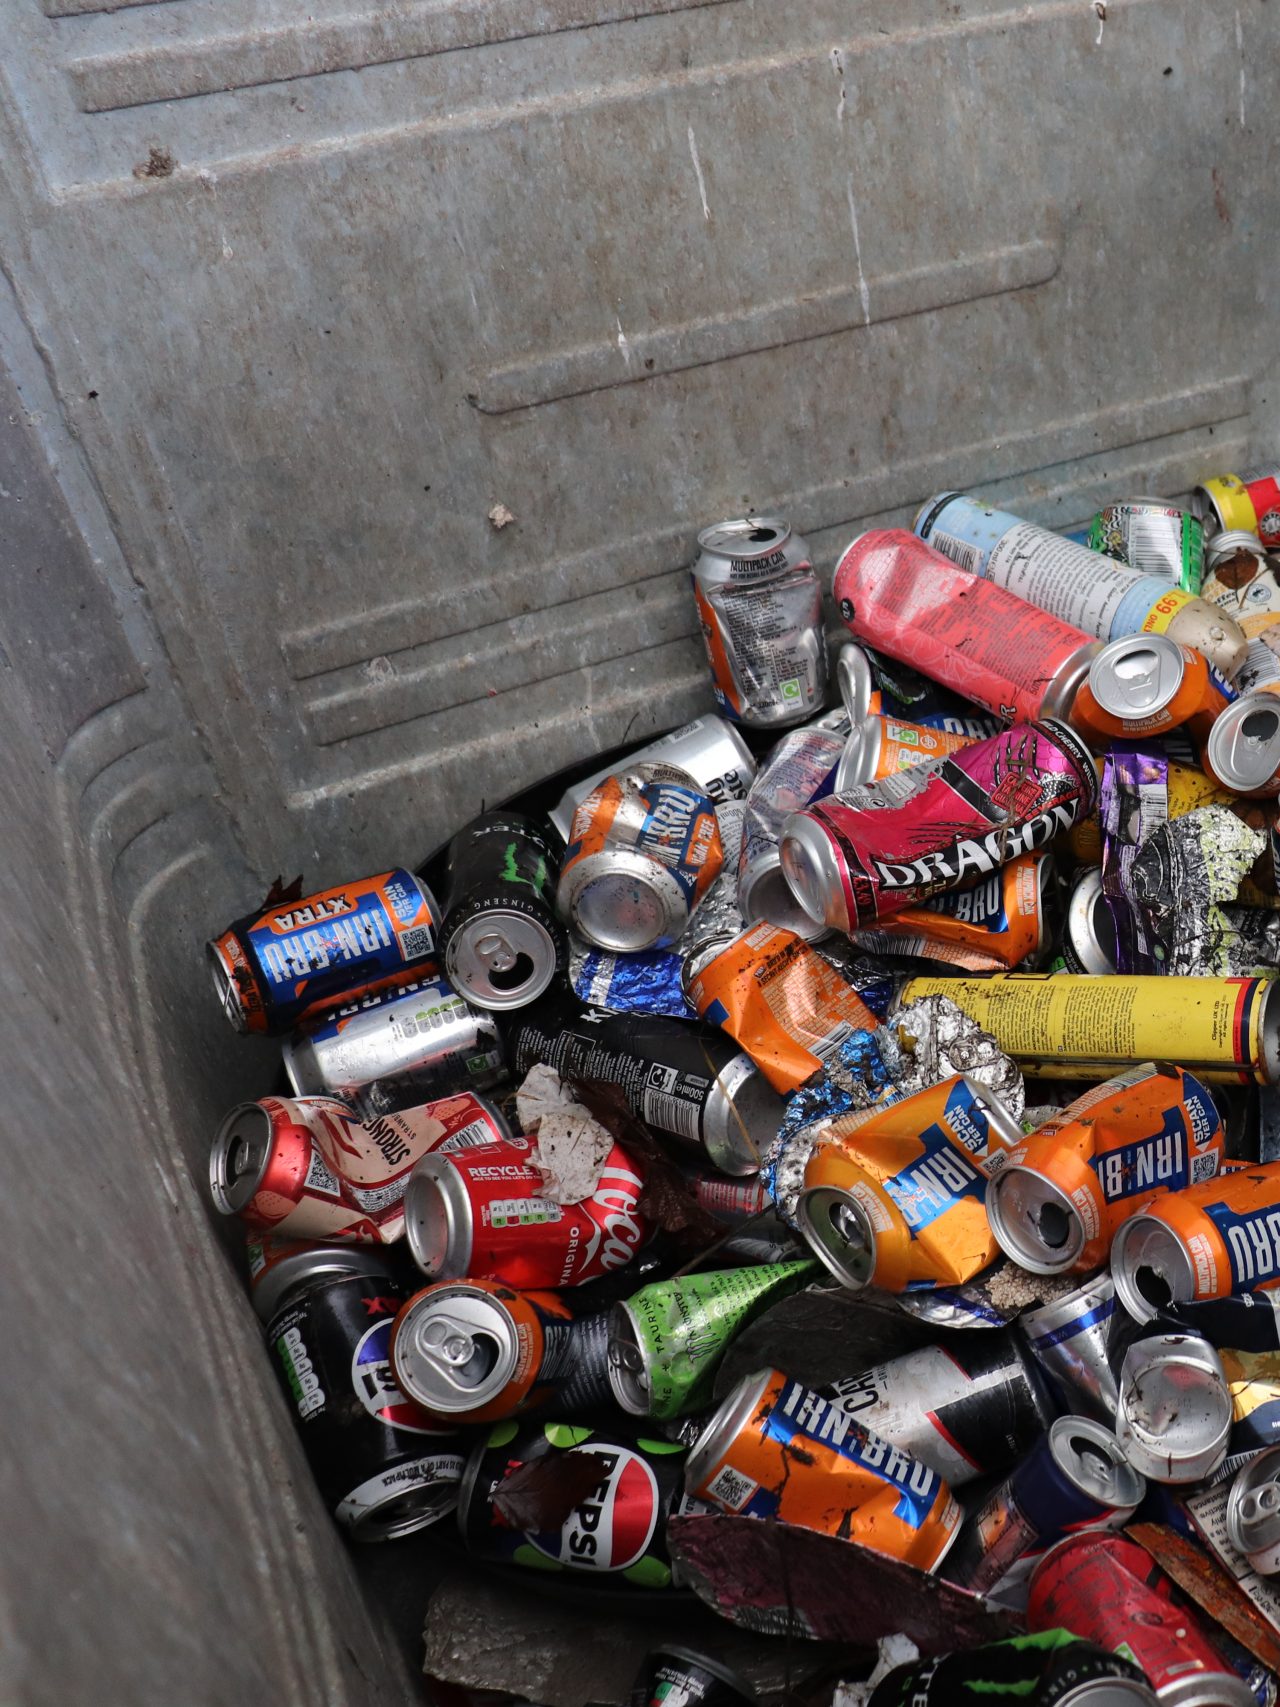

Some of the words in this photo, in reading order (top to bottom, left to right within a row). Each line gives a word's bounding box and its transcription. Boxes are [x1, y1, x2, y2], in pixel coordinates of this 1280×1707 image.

[729, 555, 771, 572] MULTIPACK
[646, 789, 696, 837] BRU
[878, 798, 1080, 887] DRAGON
[274, 894, 348, 933] XTRA
[383, 883, 406, 919] SCAN
[472, 898, 534, 911] GINSENG
[955, 881, 1001, 923] BRU
[262, 929, 330, 982] BRU
[331, 908, 390, 960] IRN
[1210, 1020, 1219, 1040] Clipper
[1213, 1010, 1218, 1018] UK
[1183, 1095, 1202, 1149] SCAN
[1200, 1095, 1211, 1117] CAN
[942, 1105, 978, 1154] SCAN
[1200, 1118, 1212, 1141] YER
[468, 1165, 531, 1178] RECYCLE
[911, 1147, 978, 1201] IRN
[1136, 1131, 1184, 1188] IRN
[557, 1227, 579, 1286] ORIGINA
[782, 1385, 850, 1446] IRN
[861, 1436, 934, 1497] BRU
